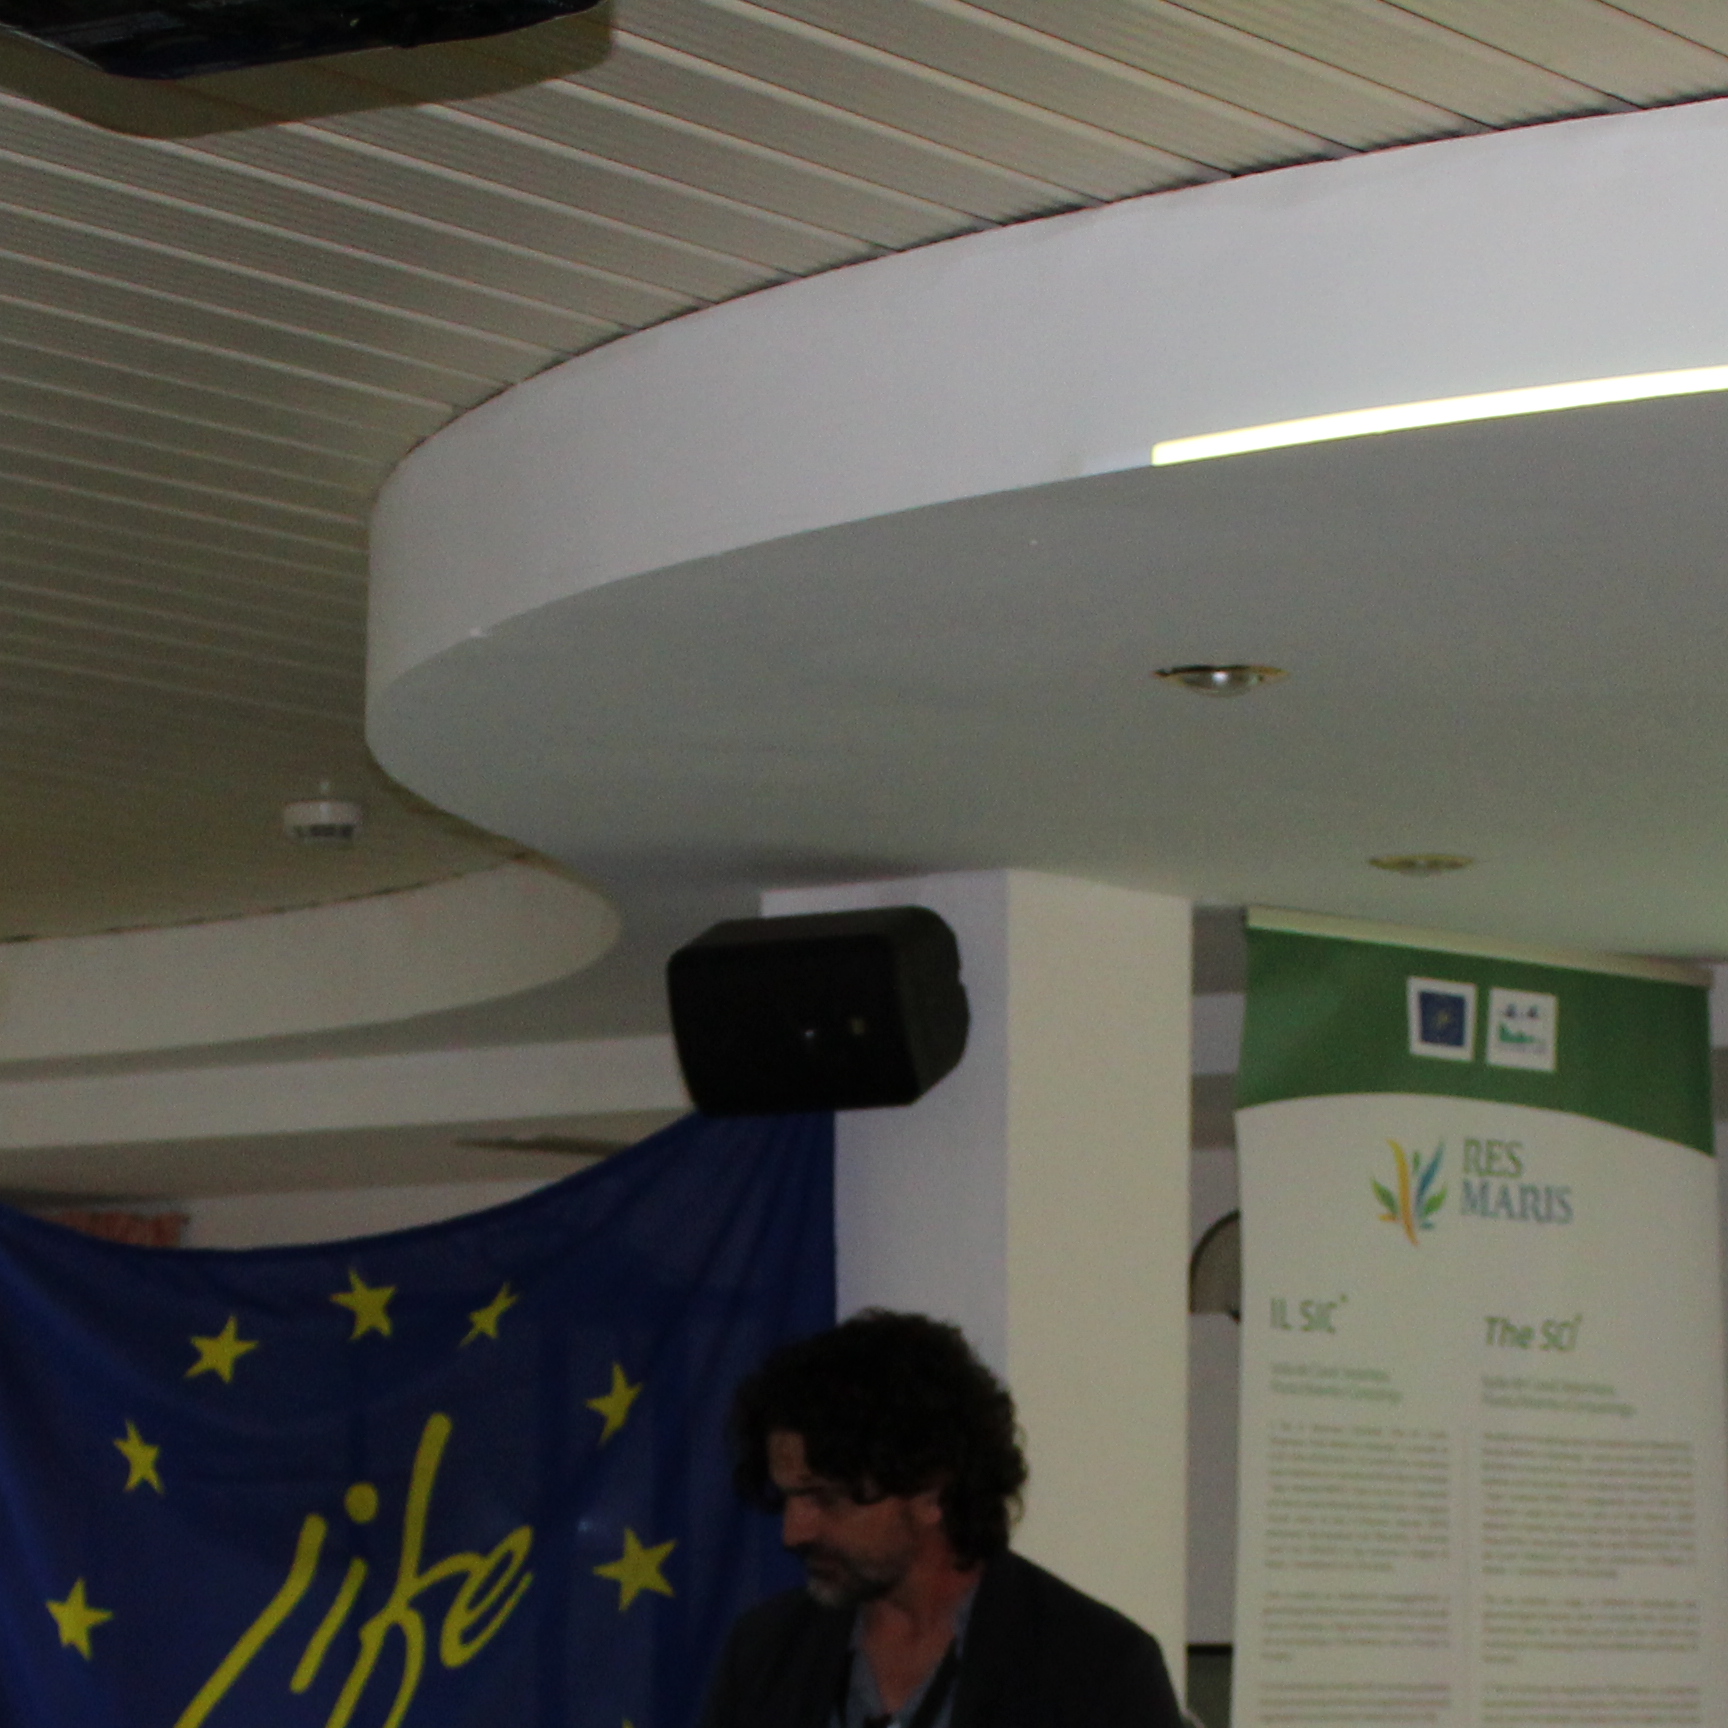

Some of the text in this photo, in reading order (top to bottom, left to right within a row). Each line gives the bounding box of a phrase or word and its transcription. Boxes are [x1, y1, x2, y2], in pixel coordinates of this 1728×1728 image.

[1463, 1138, 1523, 1178] RES
[1460, 1178, 1574, 1225] MARIS
[1483, 1315, 1534, 1350] The
